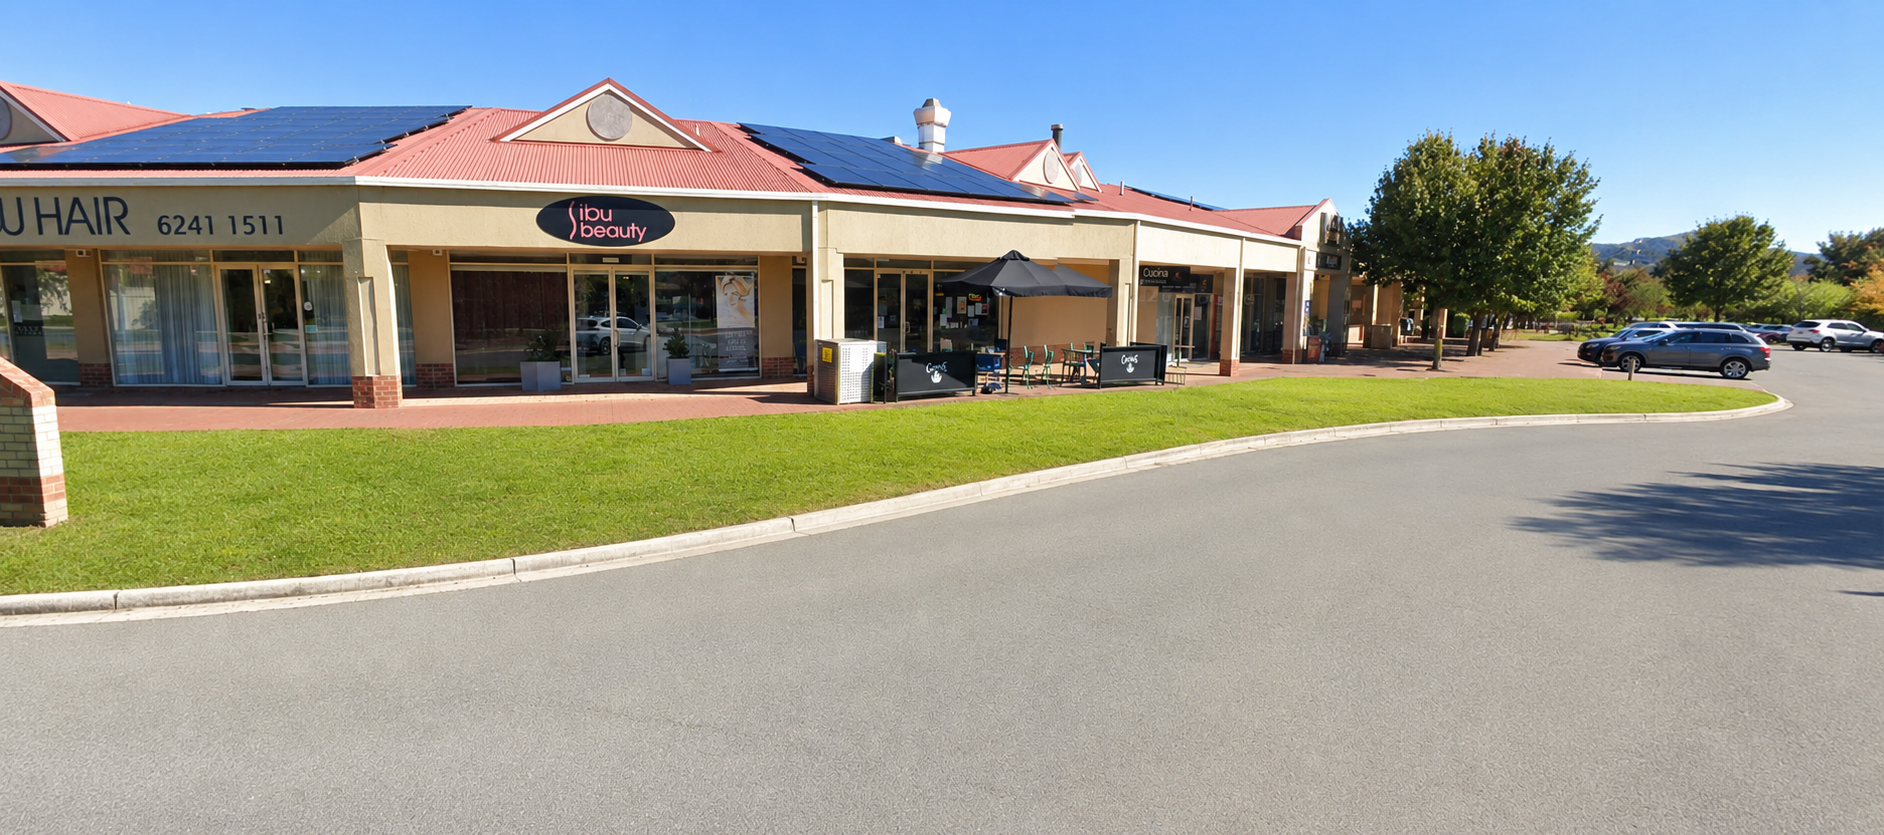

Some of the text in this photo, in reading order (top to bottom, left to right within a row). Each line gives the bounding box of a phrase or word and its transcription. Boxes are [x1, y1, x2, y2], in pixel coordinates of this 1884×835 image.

[0, 196, 131, 236] U HAIR
[157, 215, 283, 235] 6241 1511
[580, 221, 647, 243] beauty
[1142, 267, 1169, 278] Cucina
